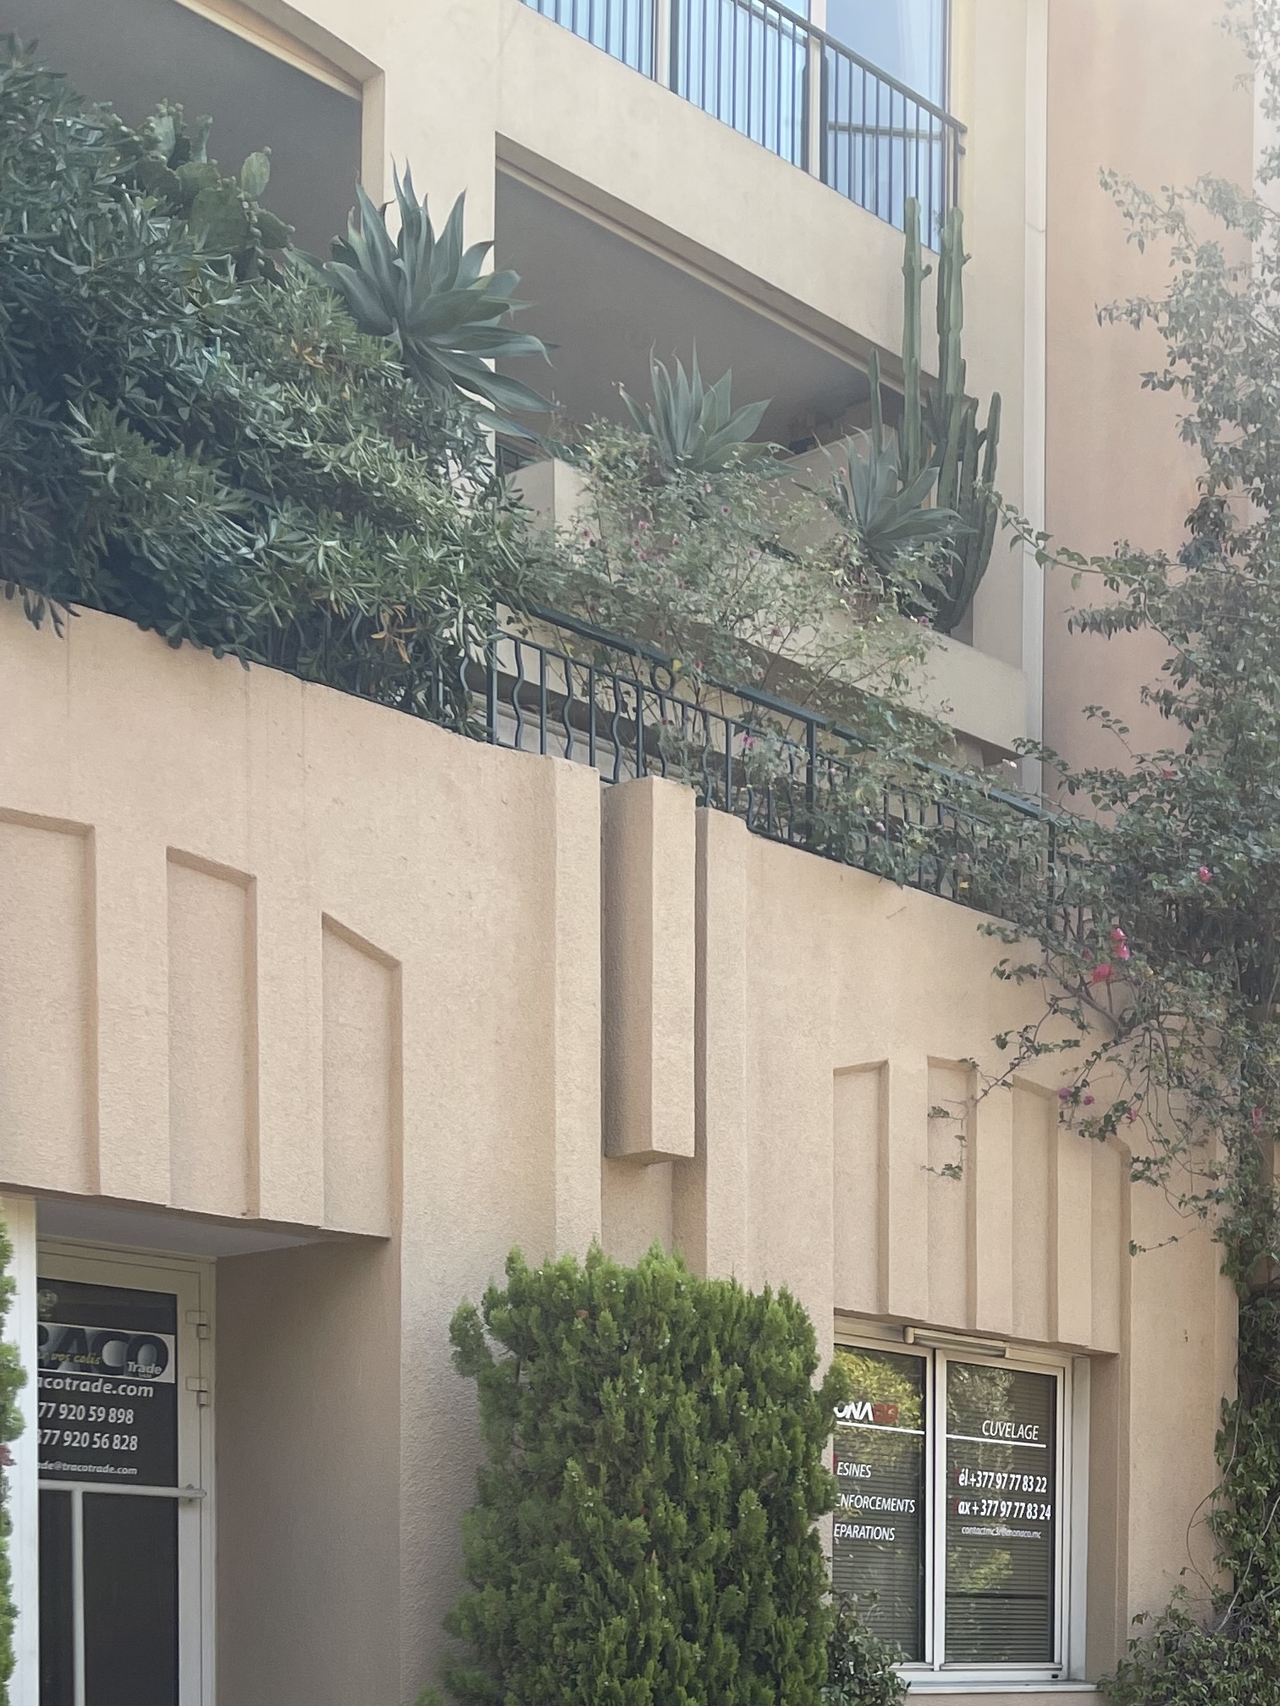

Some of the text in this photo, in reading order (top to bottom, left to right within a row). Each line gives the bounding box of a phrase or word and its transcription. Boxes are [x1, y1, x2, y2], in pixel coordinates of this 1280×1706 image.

[127, 1361, 162, 1375] Trade
[38, 1402, 134, 1424] 77 920 59 898
[982, 1420, 1039, 1440] CUVELAGE
[63, 1430, 90, 1447] 920
[92, 1432, 110, 1449] 56
[112, 1434, 138, 1451] 828
[834, 1459, 872, 1478] ESINES
[995, 1473, 1008, 1489] 97
[1009, 1474, 1021, 1490] 77
[1022, 1475, 1034, 1492] 83
[1035, 1476, 1047, 1493] 22
[835, 1493, 916, 1513] ENFORCEMENTS
[1000, 1501, 1012, 1517] 97
[1013, 1502, 1026, 1518] 77
[1026, 1503, 1038, 1520] 83
[1039, 1504, 1051, 1520] 24
[833, 1524, 895, 1541] EPARATIONS
